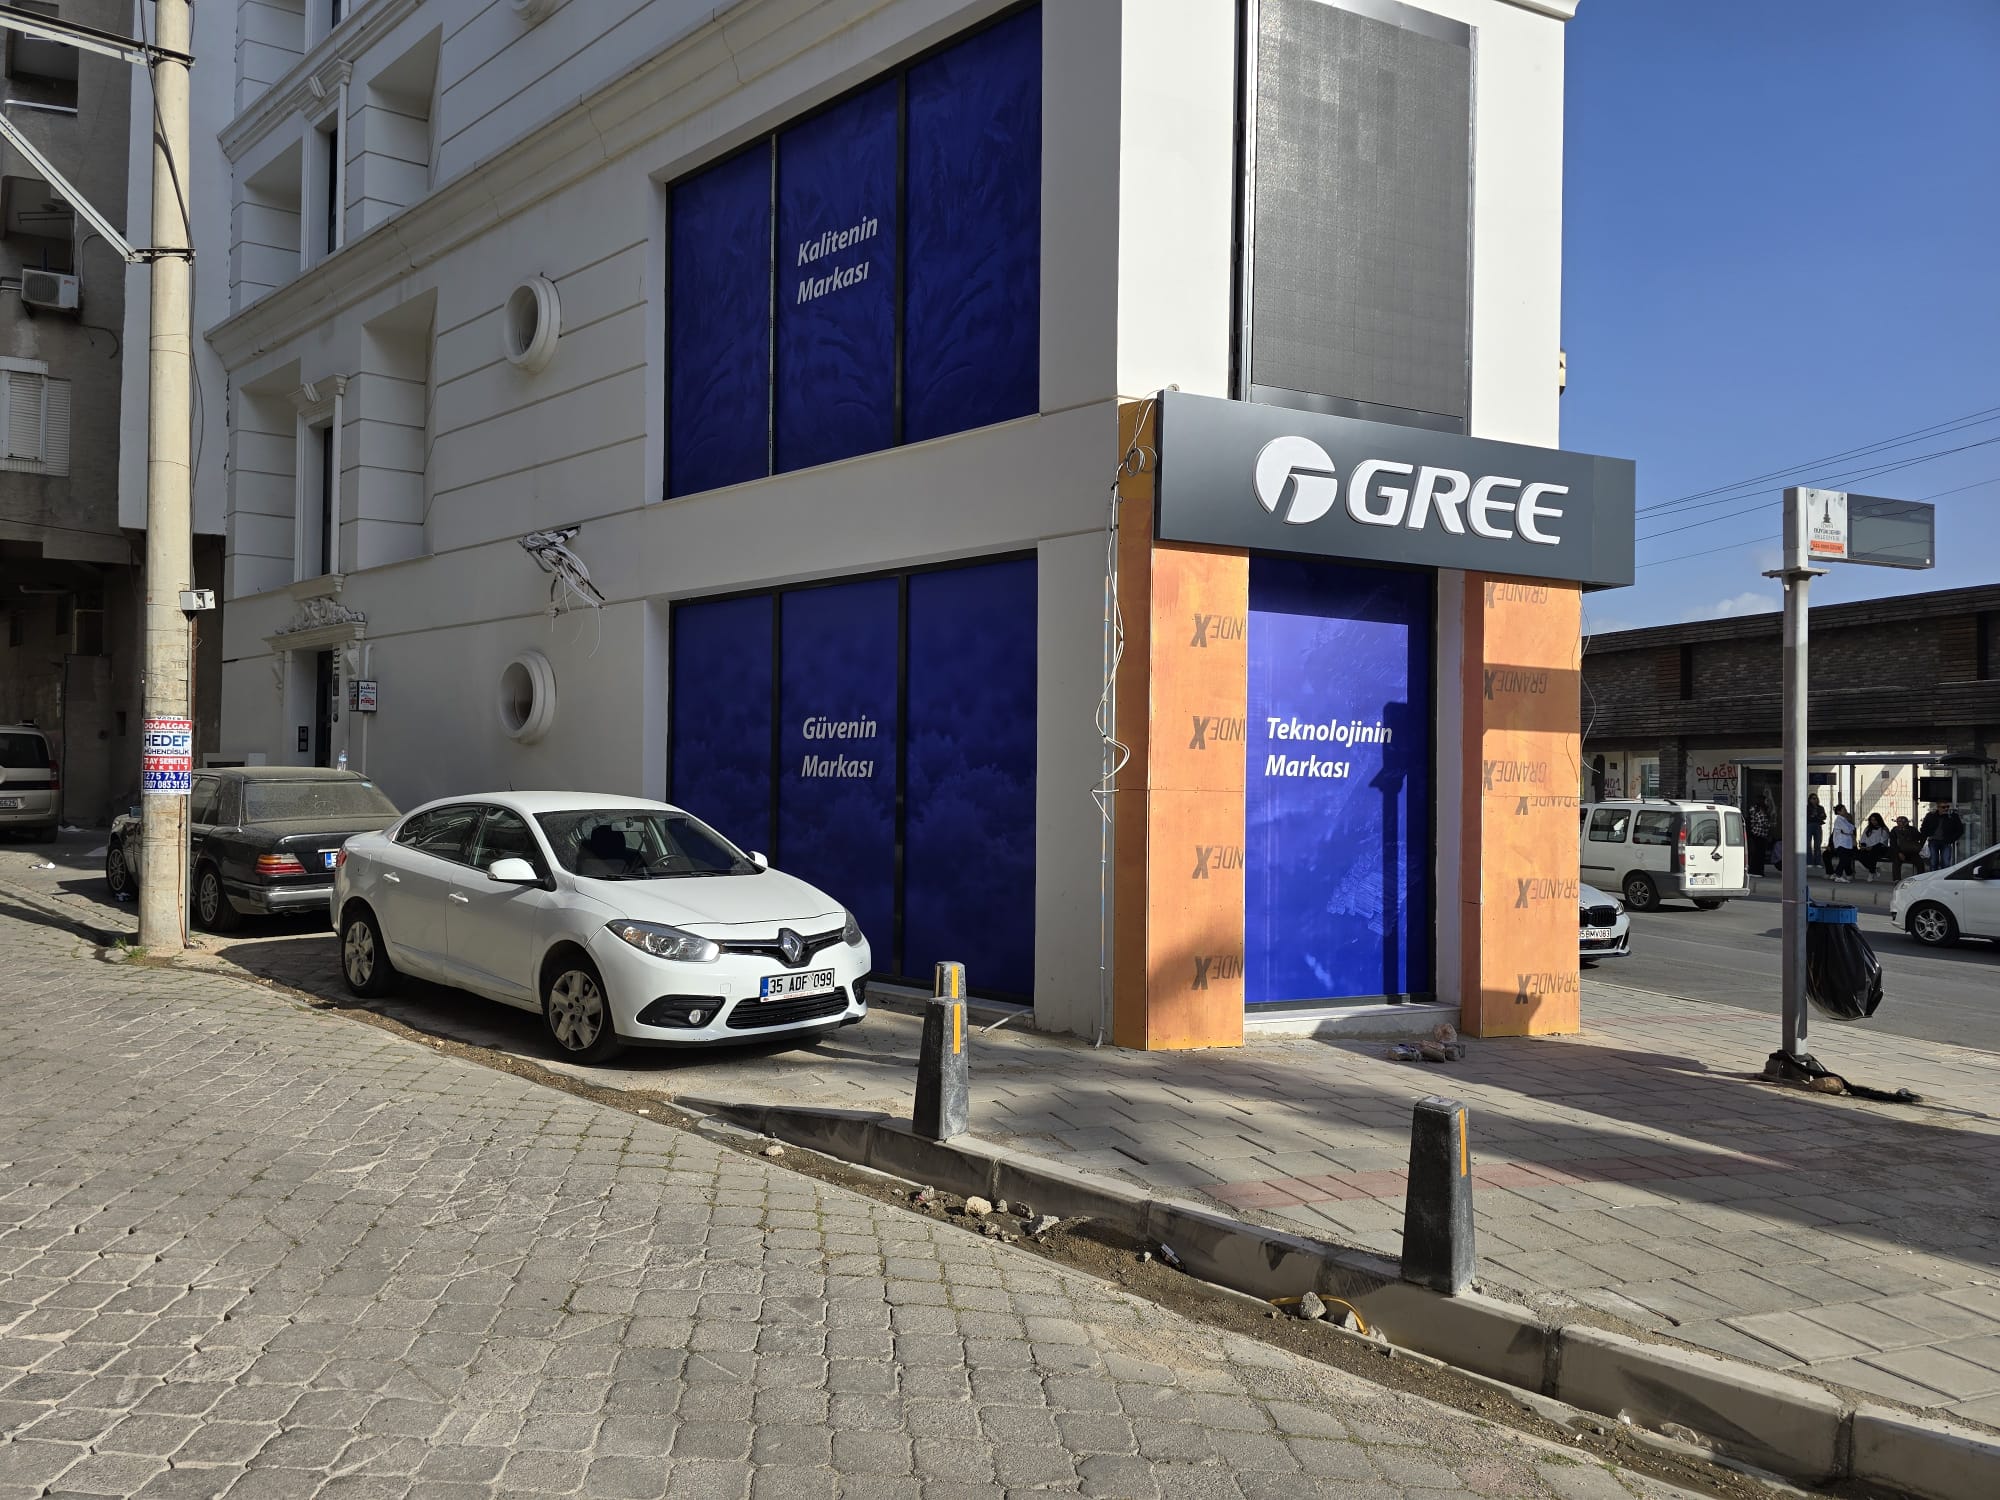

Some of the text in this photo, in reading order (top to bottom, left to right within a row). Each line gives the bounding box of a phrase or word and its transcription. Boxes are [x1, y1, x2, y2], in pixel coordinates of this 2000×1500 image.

[797, 215, 878, 267] Kalitenin
[796, 261, 870, 305] Markası
[1346, 459, 1569, 546] GREE
[1485, 582, 1549, 609] GRANDEX
[1190, 613, 1247, 648] NDEX
[1484, 668, 1548, 701] GRANDEX
[144, 721, 190, 730] DOĞALGAZ
[144, 734, 190, 747] HEDEF
[802, 714, 877, 740] Güvenin
[1189, 715, 1246, 750] NDEX
[1266, 717, 1393, 748] Teknolojinin
[144, 747, 190, 755] MÜHENDİSLİK
[801, 753, 874, 778] Markası
[1265, 754, 1350, 779] Markası
[164, 772, 176, 780] 74
[178, 772, 189, 780] 75
[1483, 759, 1547, 791] GRANDEX
[1514, 877, 1579, 909] GRANDEX
[769, 972, 832, 994] 35 ADF 099
[1515, 973, 1579, 1005] GRANDEX
